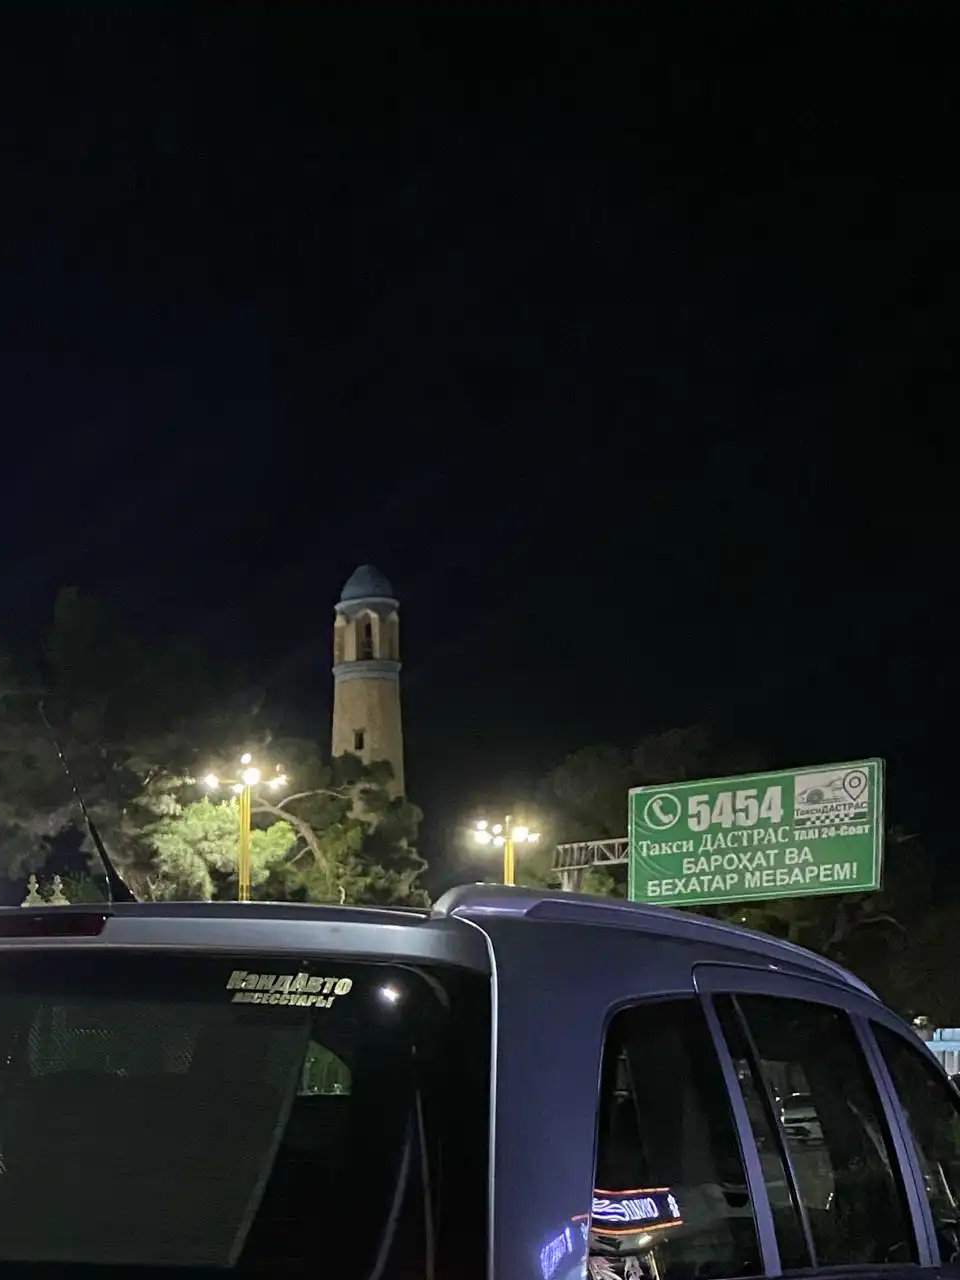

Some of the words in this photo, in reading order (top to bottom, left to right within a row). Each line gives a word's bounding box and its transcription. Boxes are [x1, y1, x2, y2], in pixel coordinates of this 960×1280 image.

[688, 786, 784, 832] 5454
[638, 839, 694, 857] Такси
[698, 826, 790, 852] ДАСТРАС
[785, 847, 814, 863] ВА
[647, 874, 738, 897] БЕХАТАР
[744, 862, 858, 889] МЕБАРЕМ!
